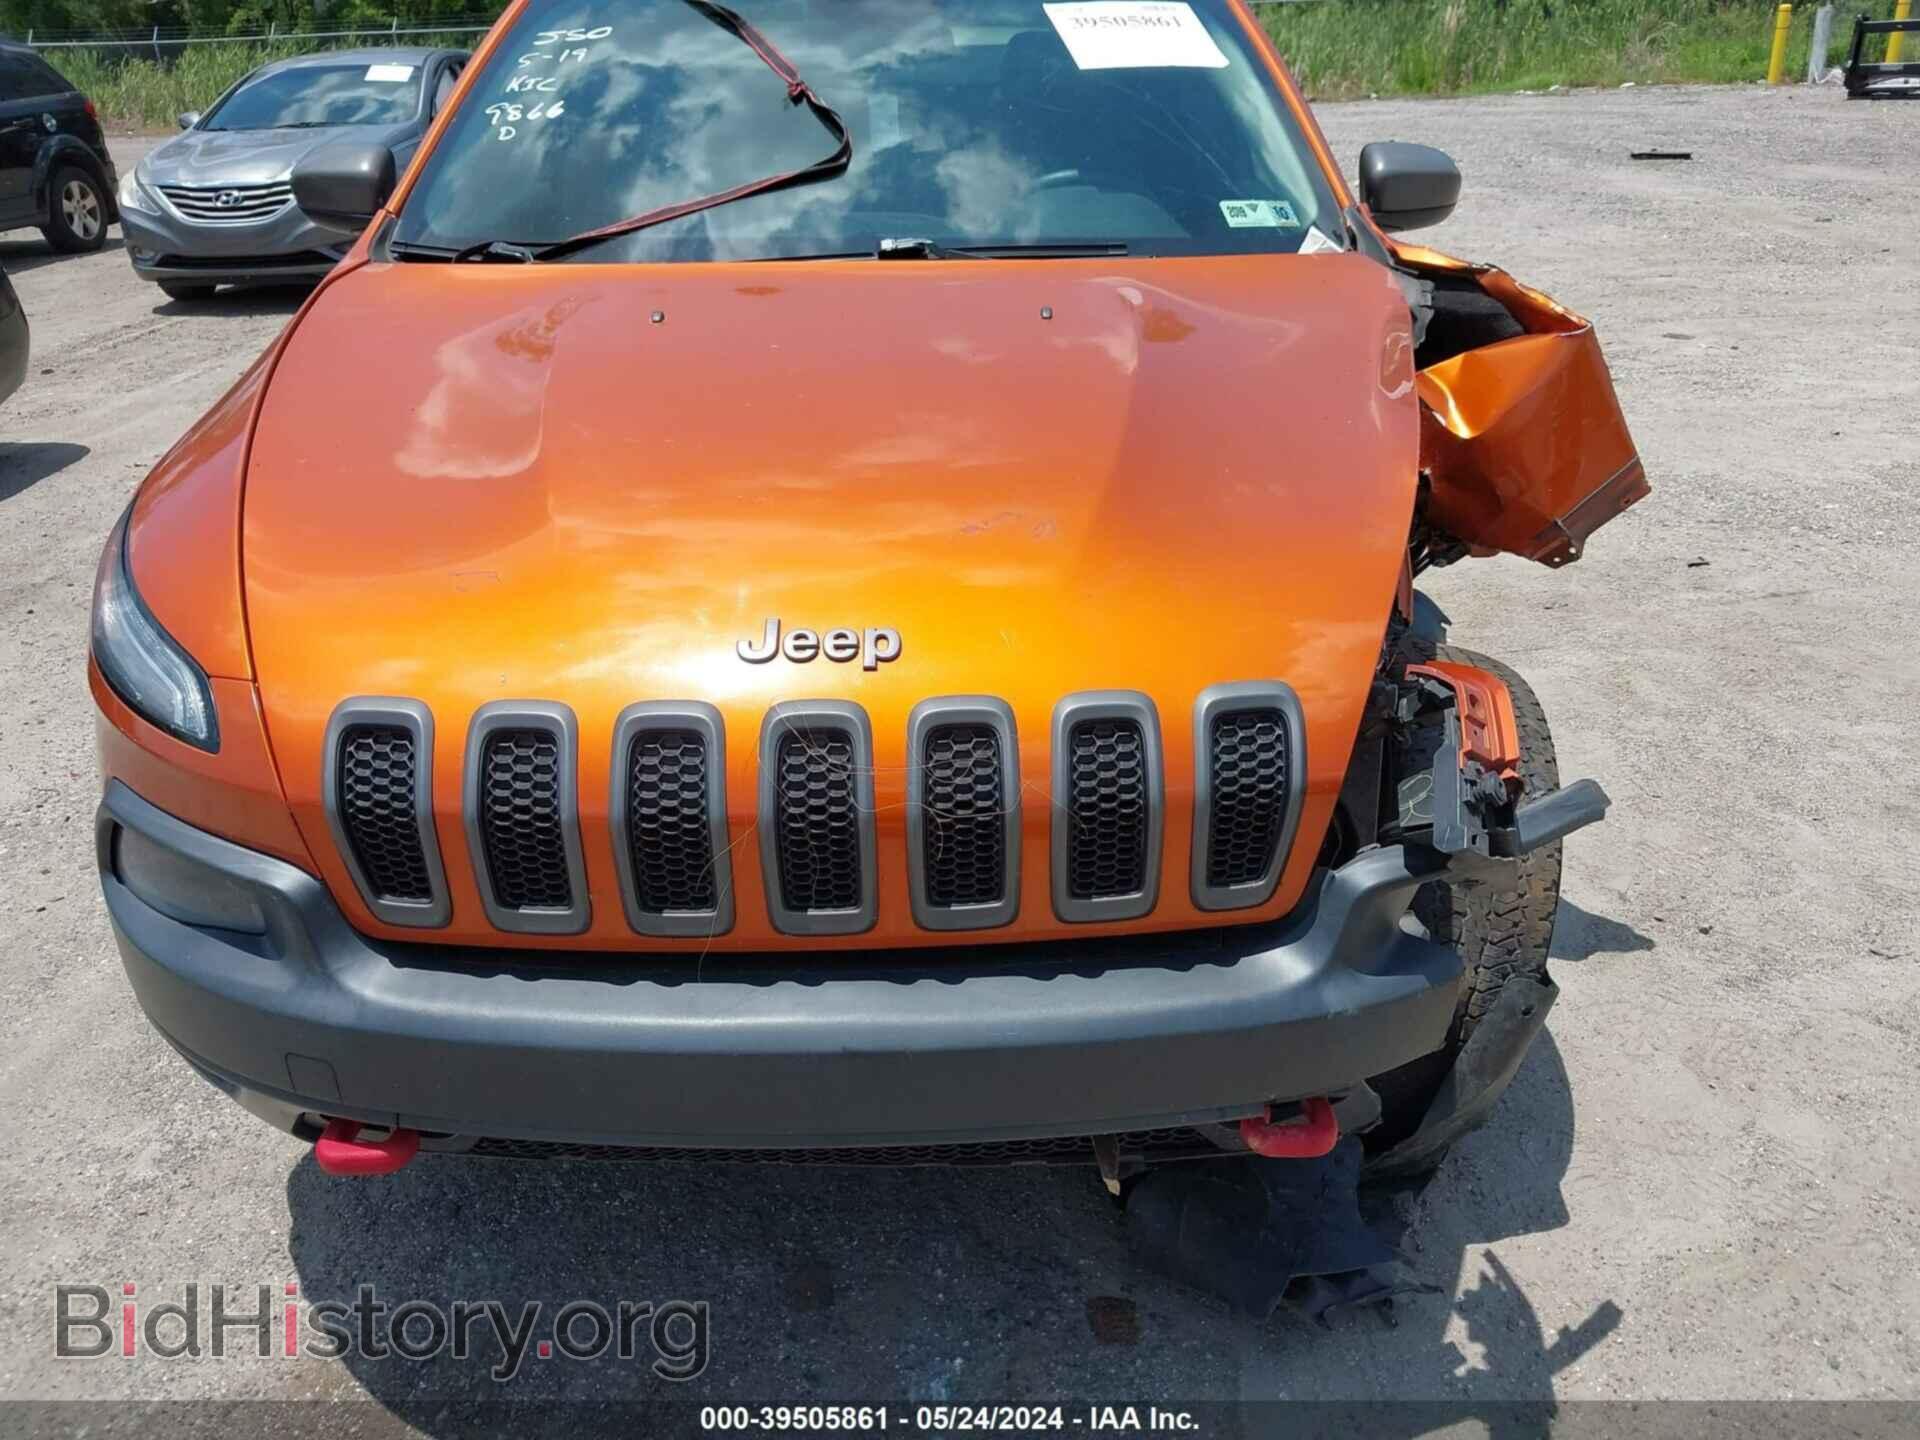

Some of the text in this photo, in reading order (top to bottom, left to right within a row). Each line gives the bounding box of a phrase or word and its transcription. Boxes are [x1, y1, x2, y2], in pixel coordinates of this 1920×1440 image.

[1067, 14, 1183, 30] 39505861
[485, 100, 565, 125] 9866
[498, 126, 517, 141] D
[736, 617, 902, 672] Jeep
